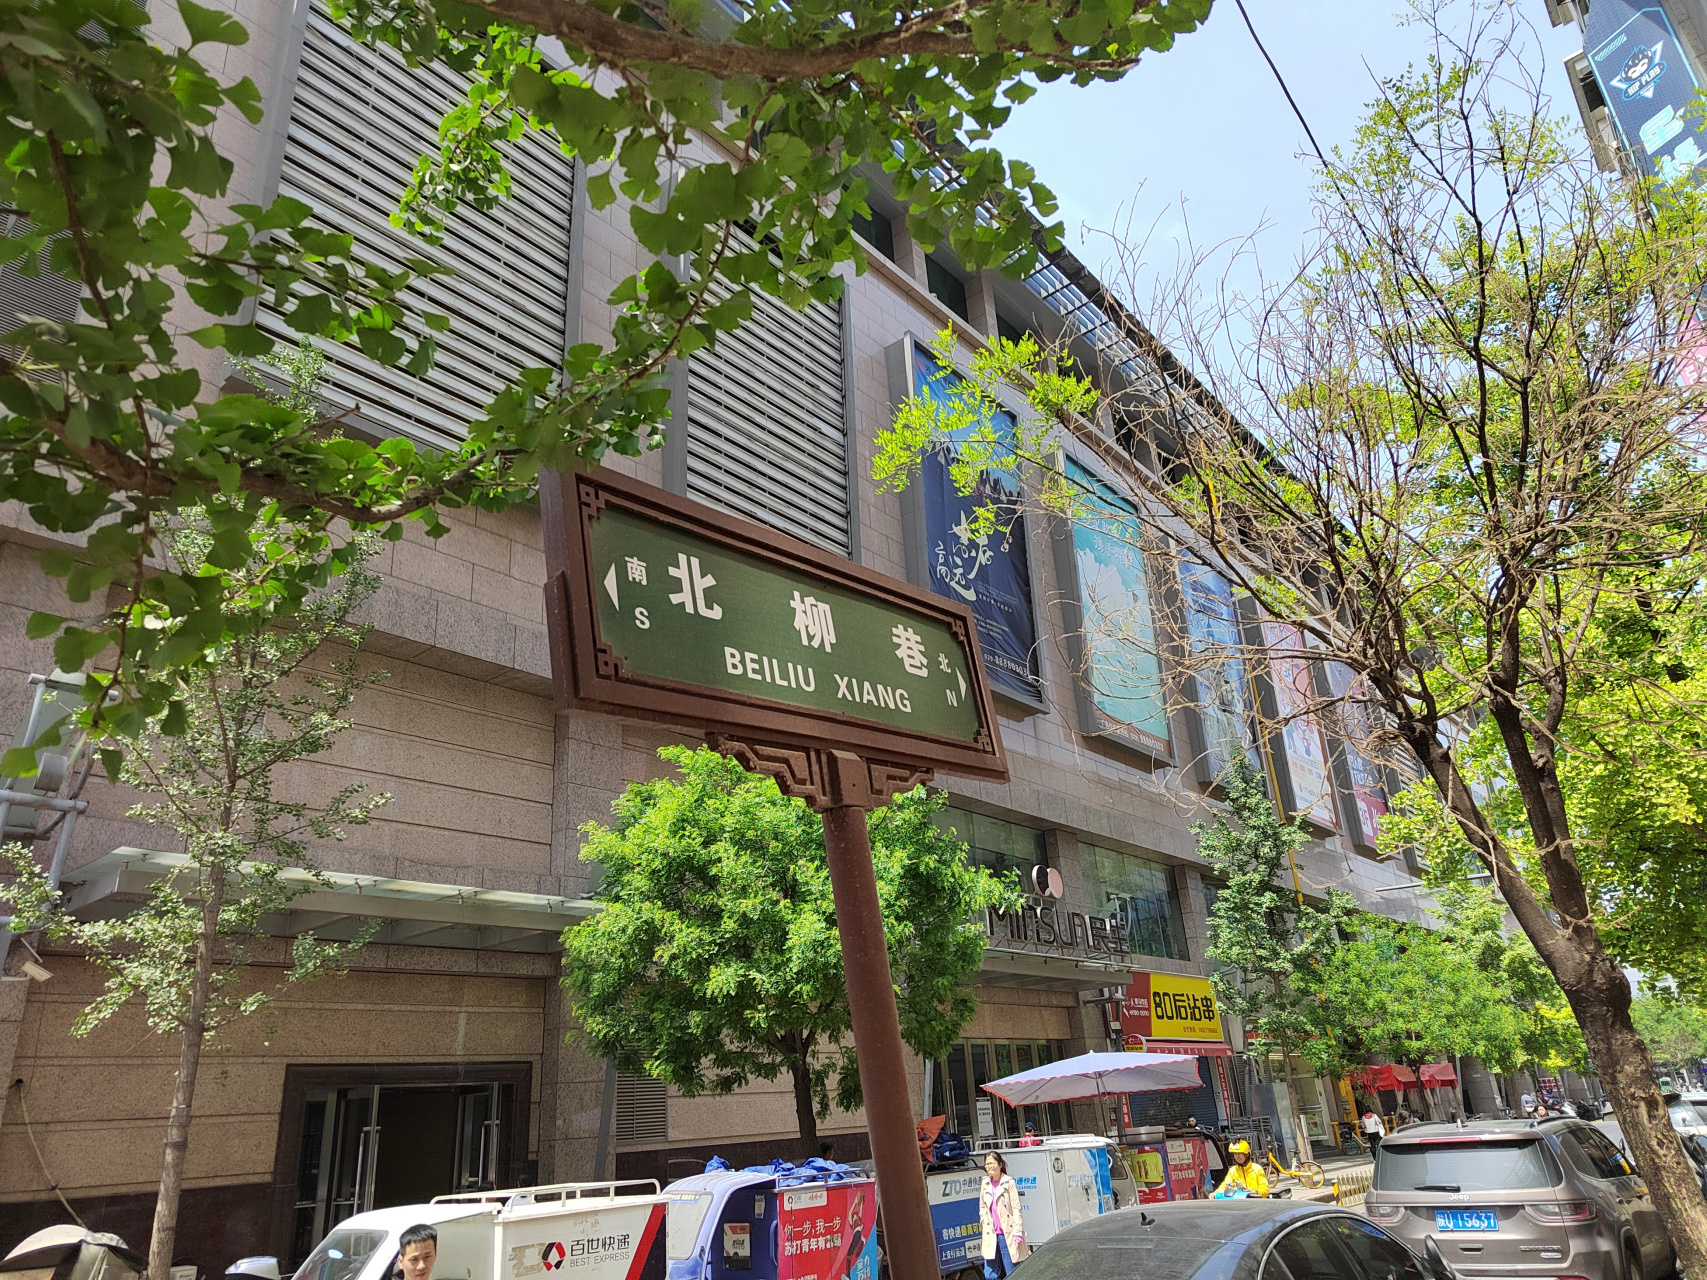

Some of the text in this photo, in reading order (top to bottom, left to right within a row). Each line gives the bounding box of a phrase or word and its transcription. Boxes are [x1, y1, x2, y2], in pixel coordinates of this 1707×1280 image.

[624, 556, 647, 587] 南
[634, 606, 651, 630] S
[668, 552, 929, 678] 北柳巷
[936, 652, 953, 675] 北
[724, 646, 912, 714] BEILIU XIANG
[945, 688, 958, 708] N
[1152, 991, 1216, 1023] 80后沾串
[942, 1178, 962, 1197] ZTO
[1448, 1193, 1471, 1202] Jeep
[571, 1233, 630, 1257] 百世快递
[570, 1251, 630, 1268] BEST EXPRESS
